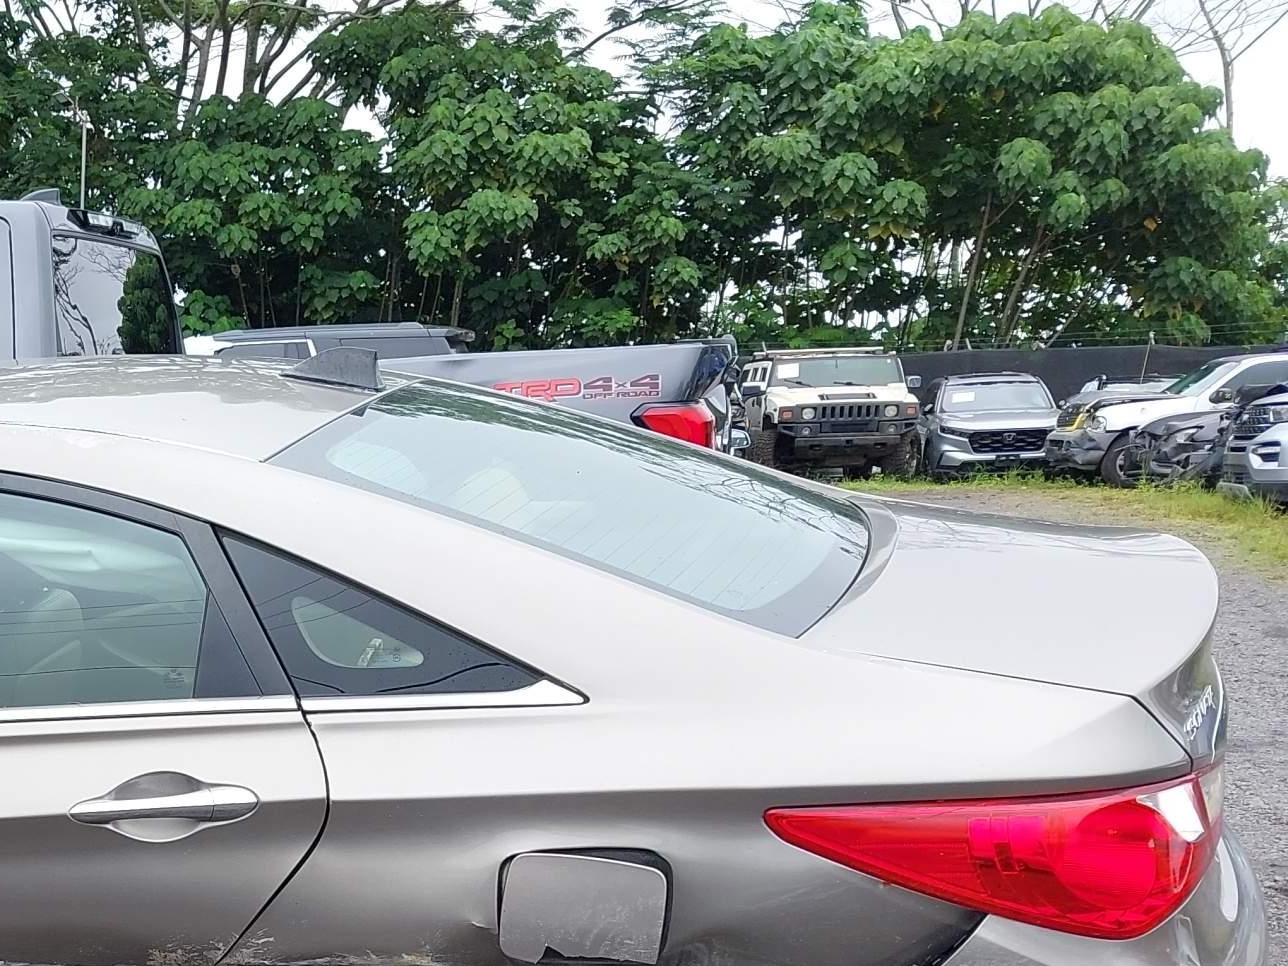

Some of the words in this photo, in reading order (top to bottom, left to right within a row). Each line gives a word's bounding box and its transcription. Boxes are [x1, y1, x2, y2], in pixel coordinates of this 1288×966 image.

[493, 378, 582, 402] TRD
[583, 374, 661, 392] 4x4
[583, 392, 613, 400] OFF
[616, 390, 660, 398] ROAD
